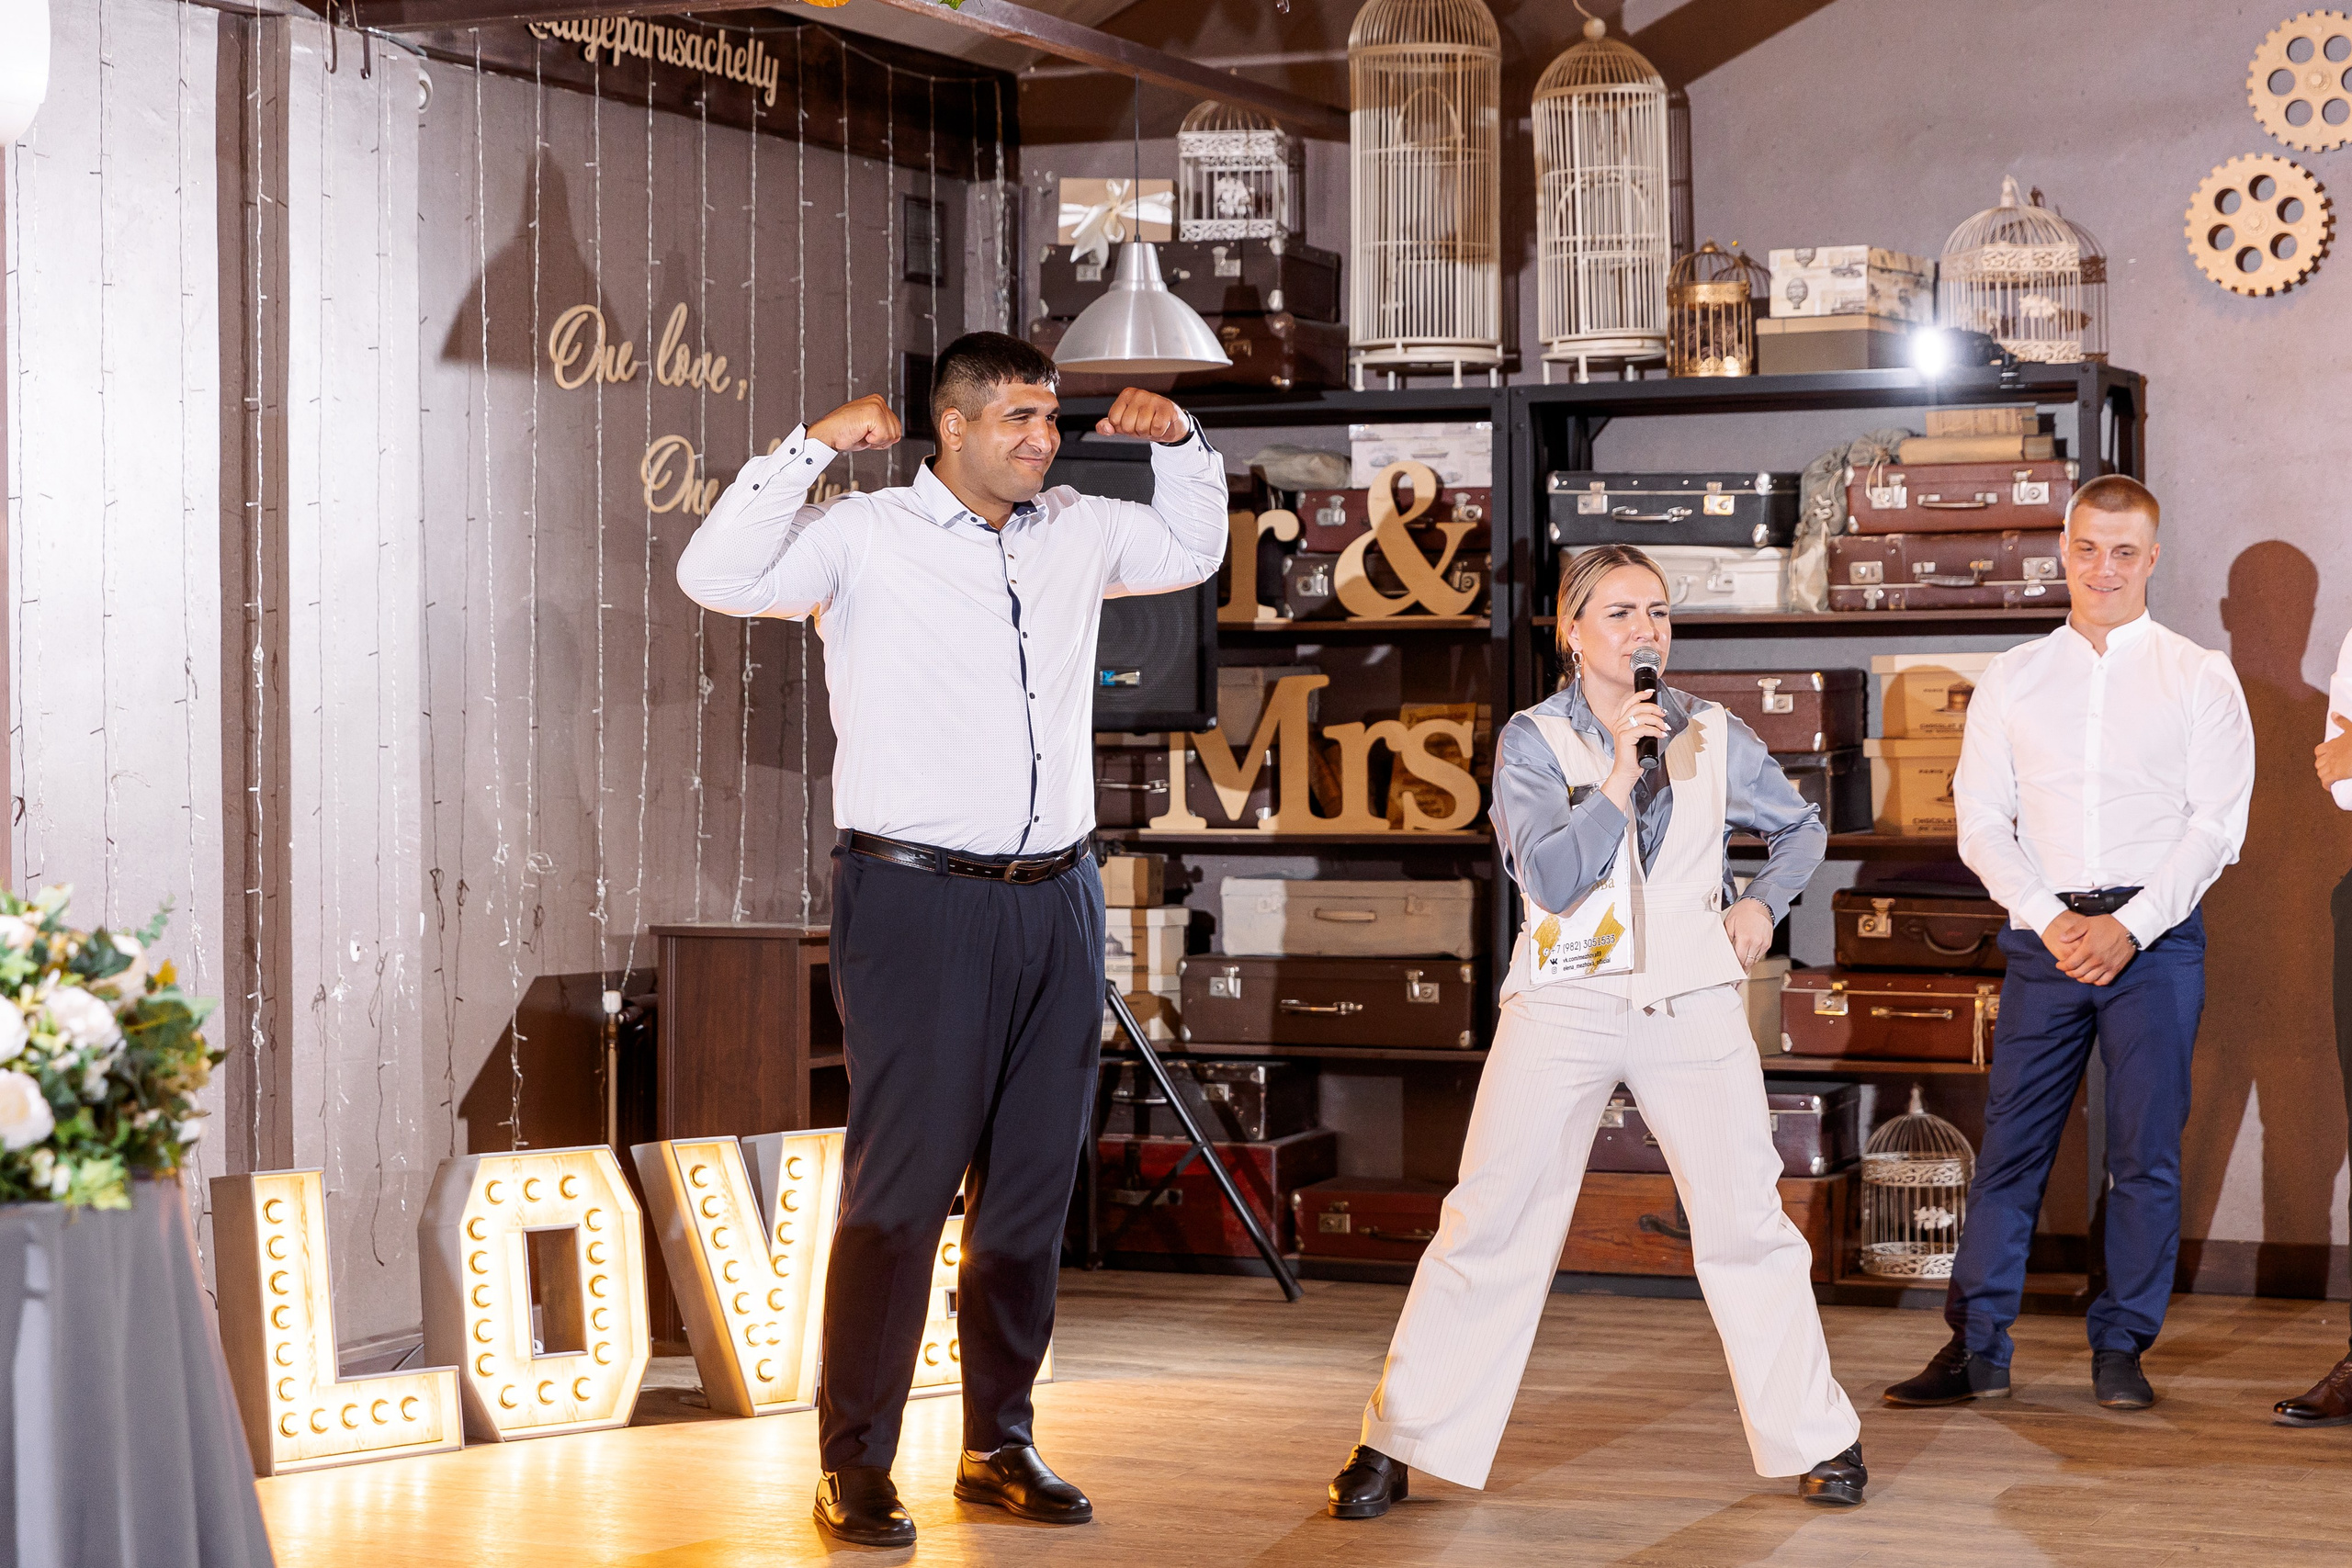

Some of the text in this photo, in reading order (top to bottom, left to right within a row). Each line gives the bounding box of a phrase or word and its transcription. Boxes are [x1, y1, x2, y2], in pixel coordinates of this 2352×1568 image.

[549, 304, 639, 390] One
[1148, 673, 1481, 830] Mrs
[1562, 941, 1582, 954] (982)
